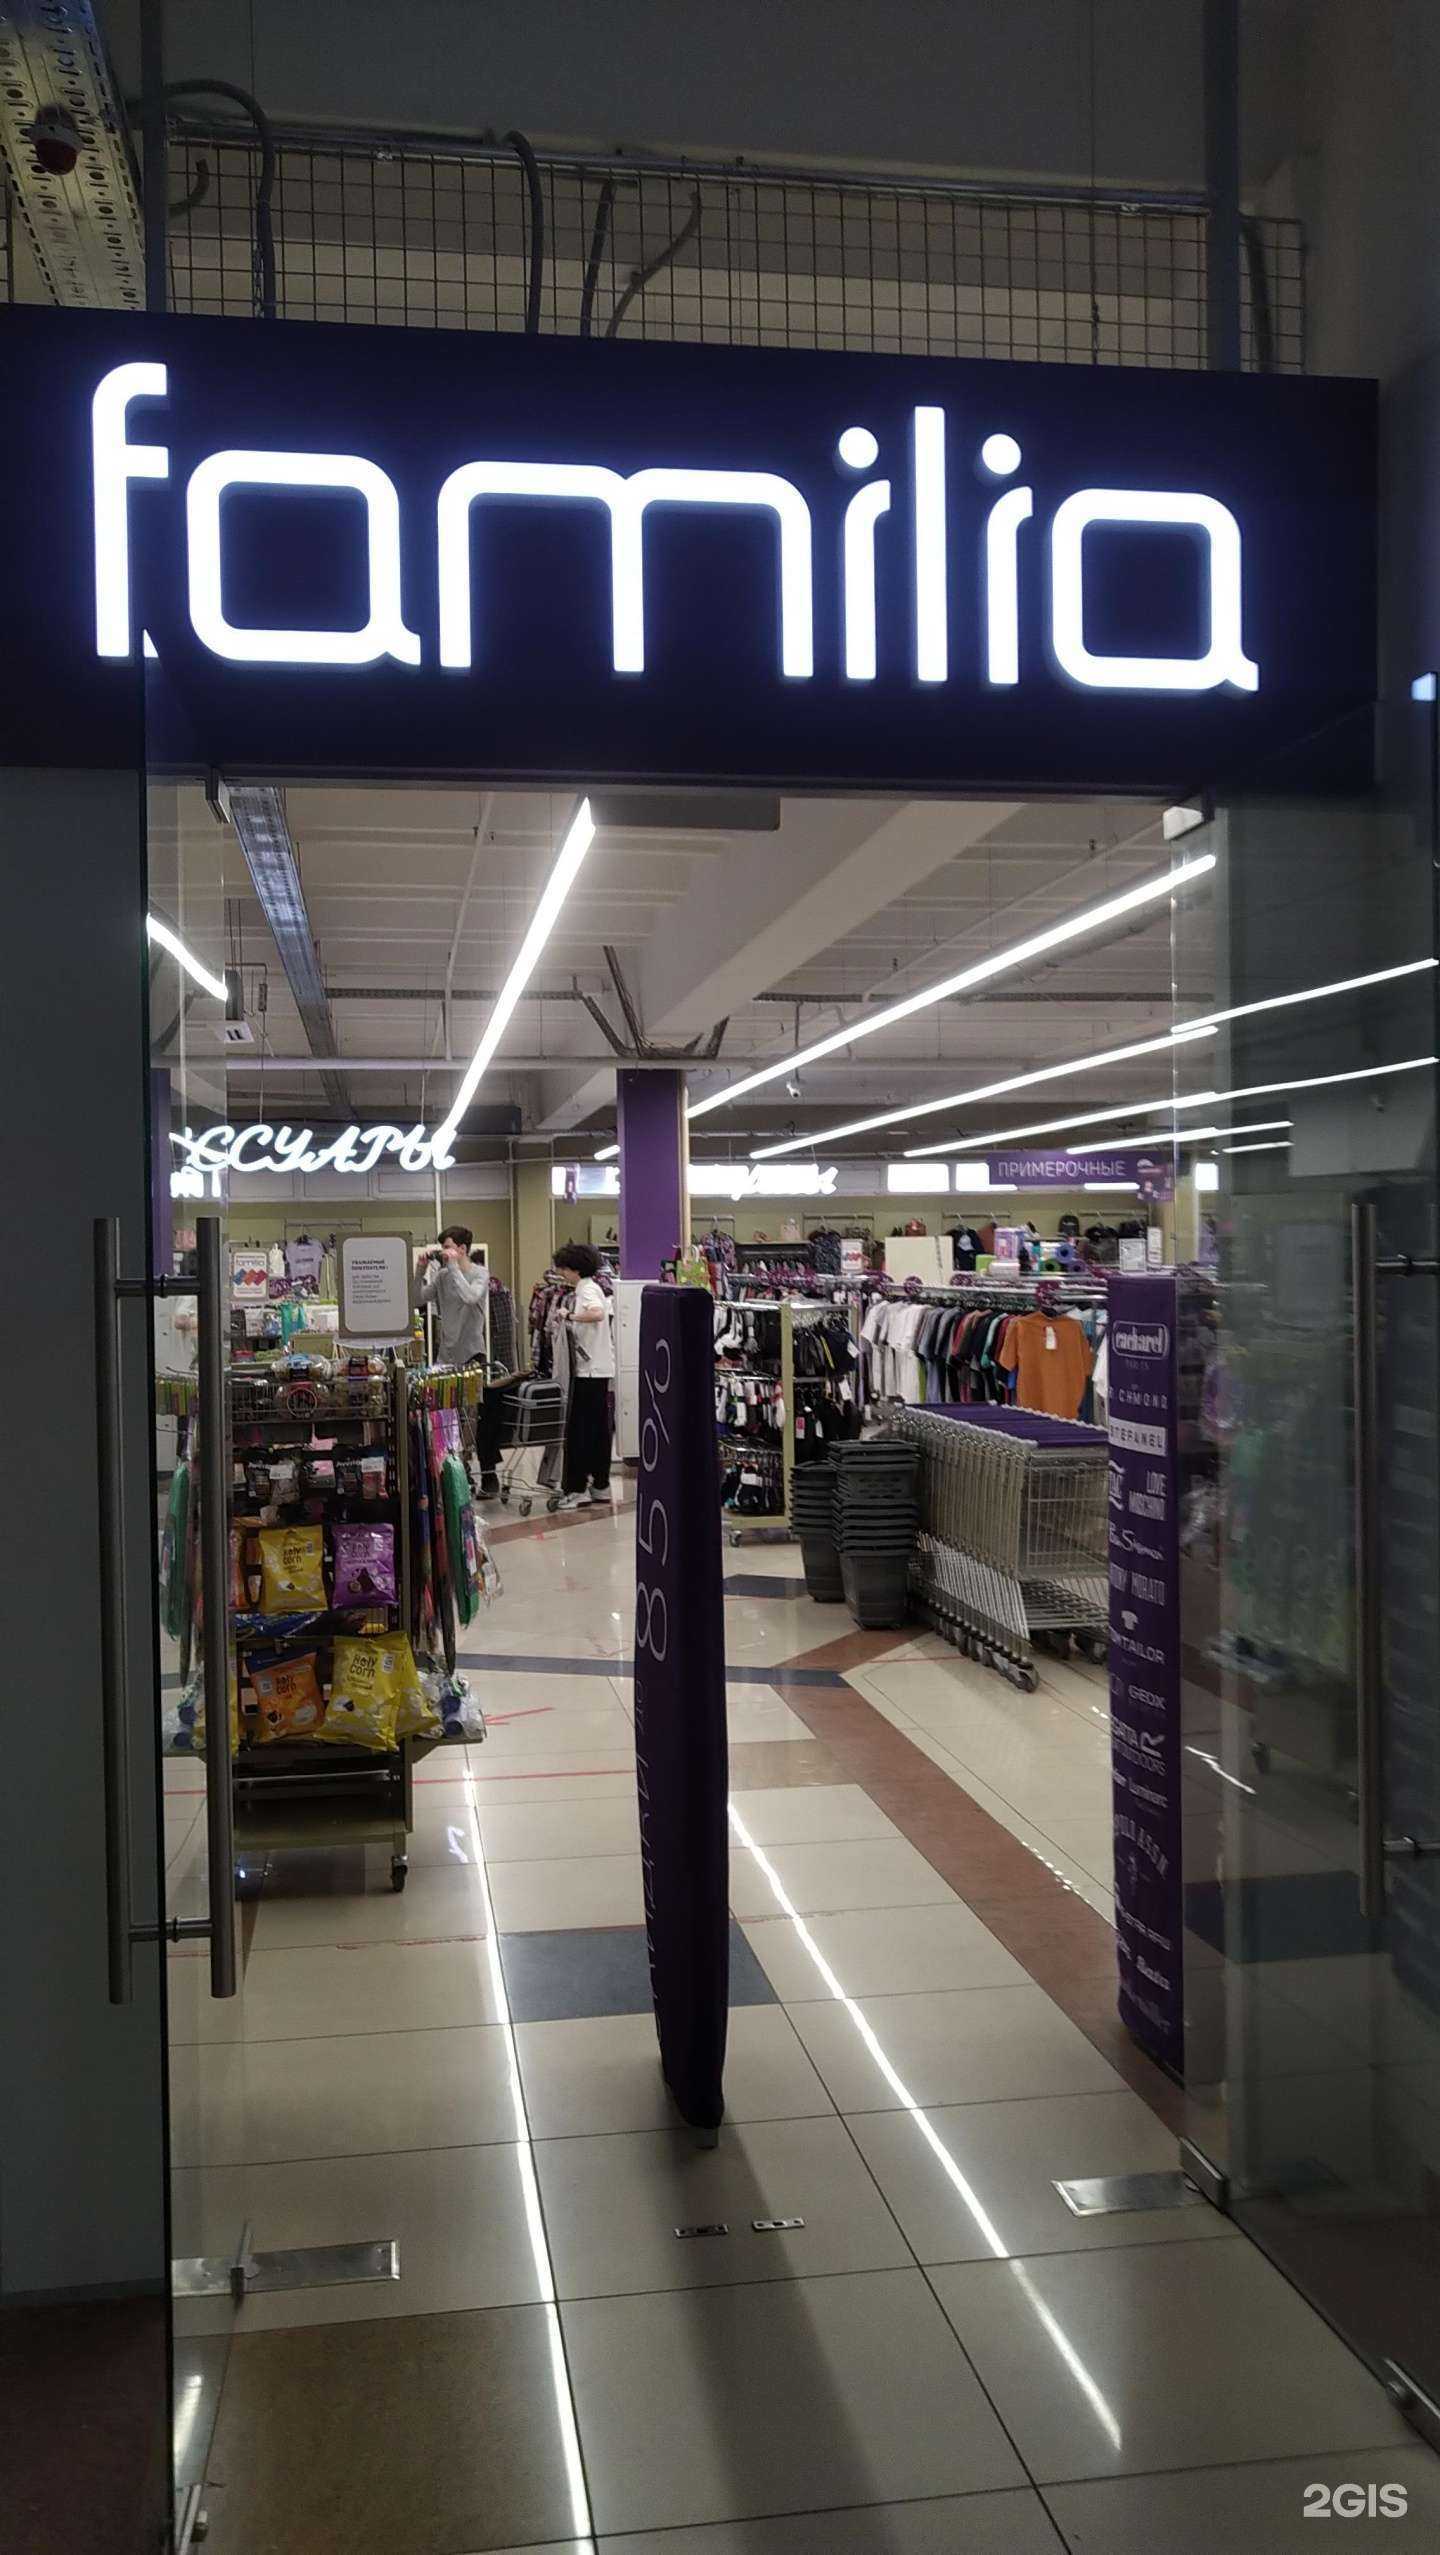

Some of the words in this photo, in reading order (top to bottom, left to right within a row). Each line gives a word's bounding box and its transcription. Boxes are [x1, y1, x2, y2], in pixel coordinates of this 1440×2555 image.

[92, 361, 1260, 693] familia
[998, 1160, 1127, 1178] ПРИМЕРОЧНЫЕ
[1116, 1326, 1163, 1354] cacharel
